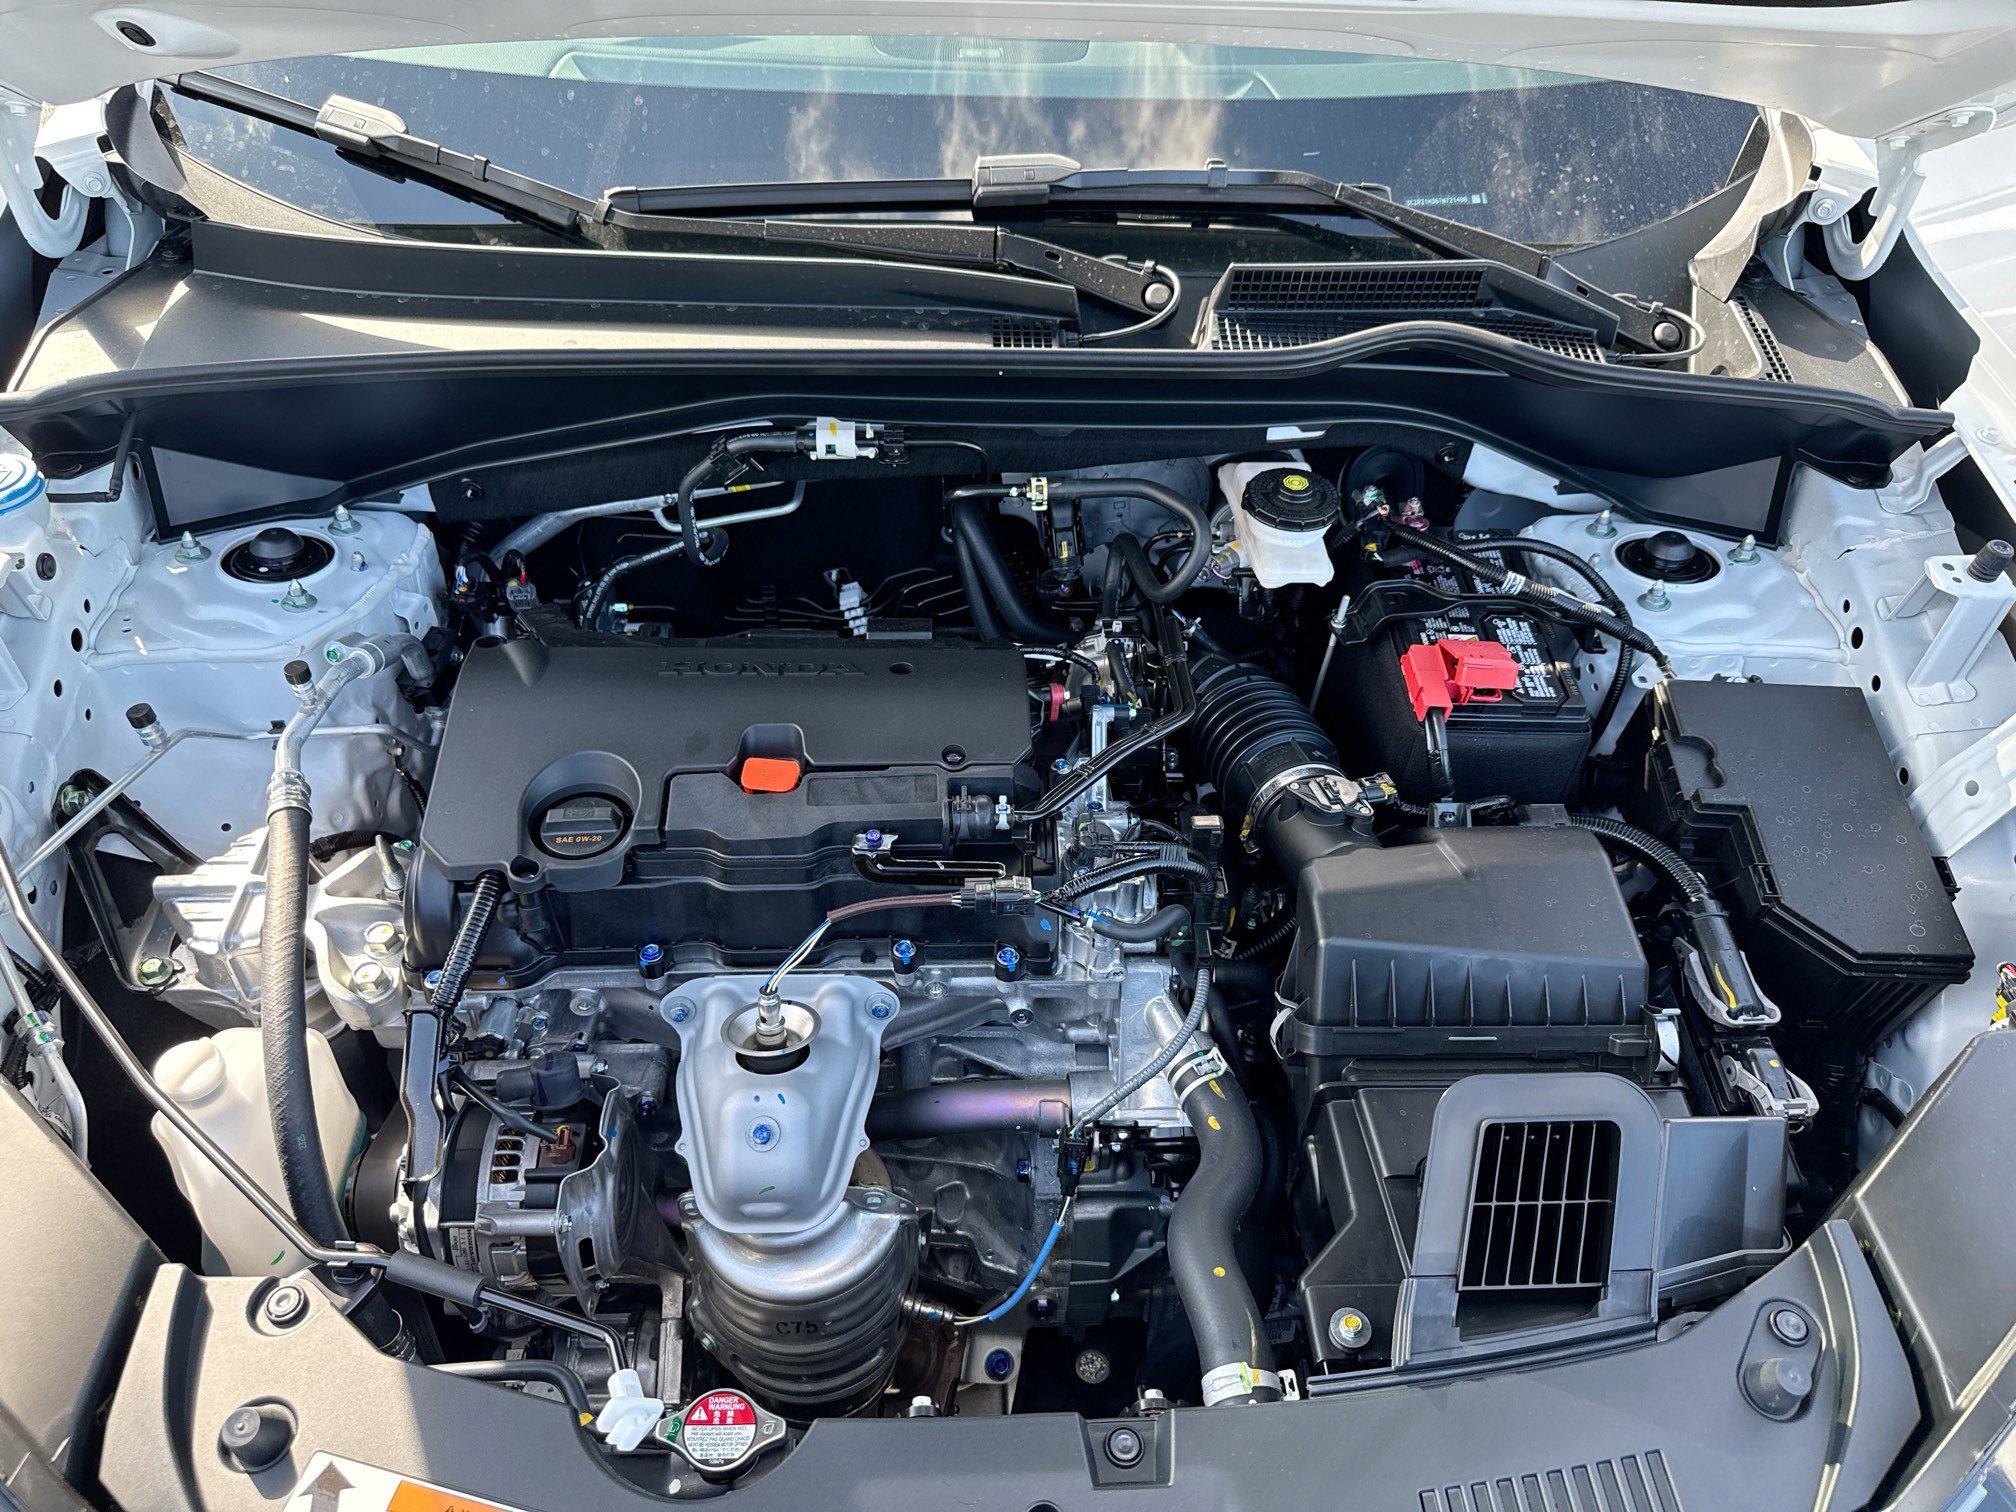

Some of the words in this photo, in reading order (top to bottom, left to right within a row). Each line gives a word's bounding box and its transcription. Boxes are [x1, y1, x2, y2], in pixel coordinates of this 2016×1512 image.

[658, 661, 869, 676] HONDA
[555, 836, 574, 844] SAE
[575, 835, 602, 843] 0W-20
